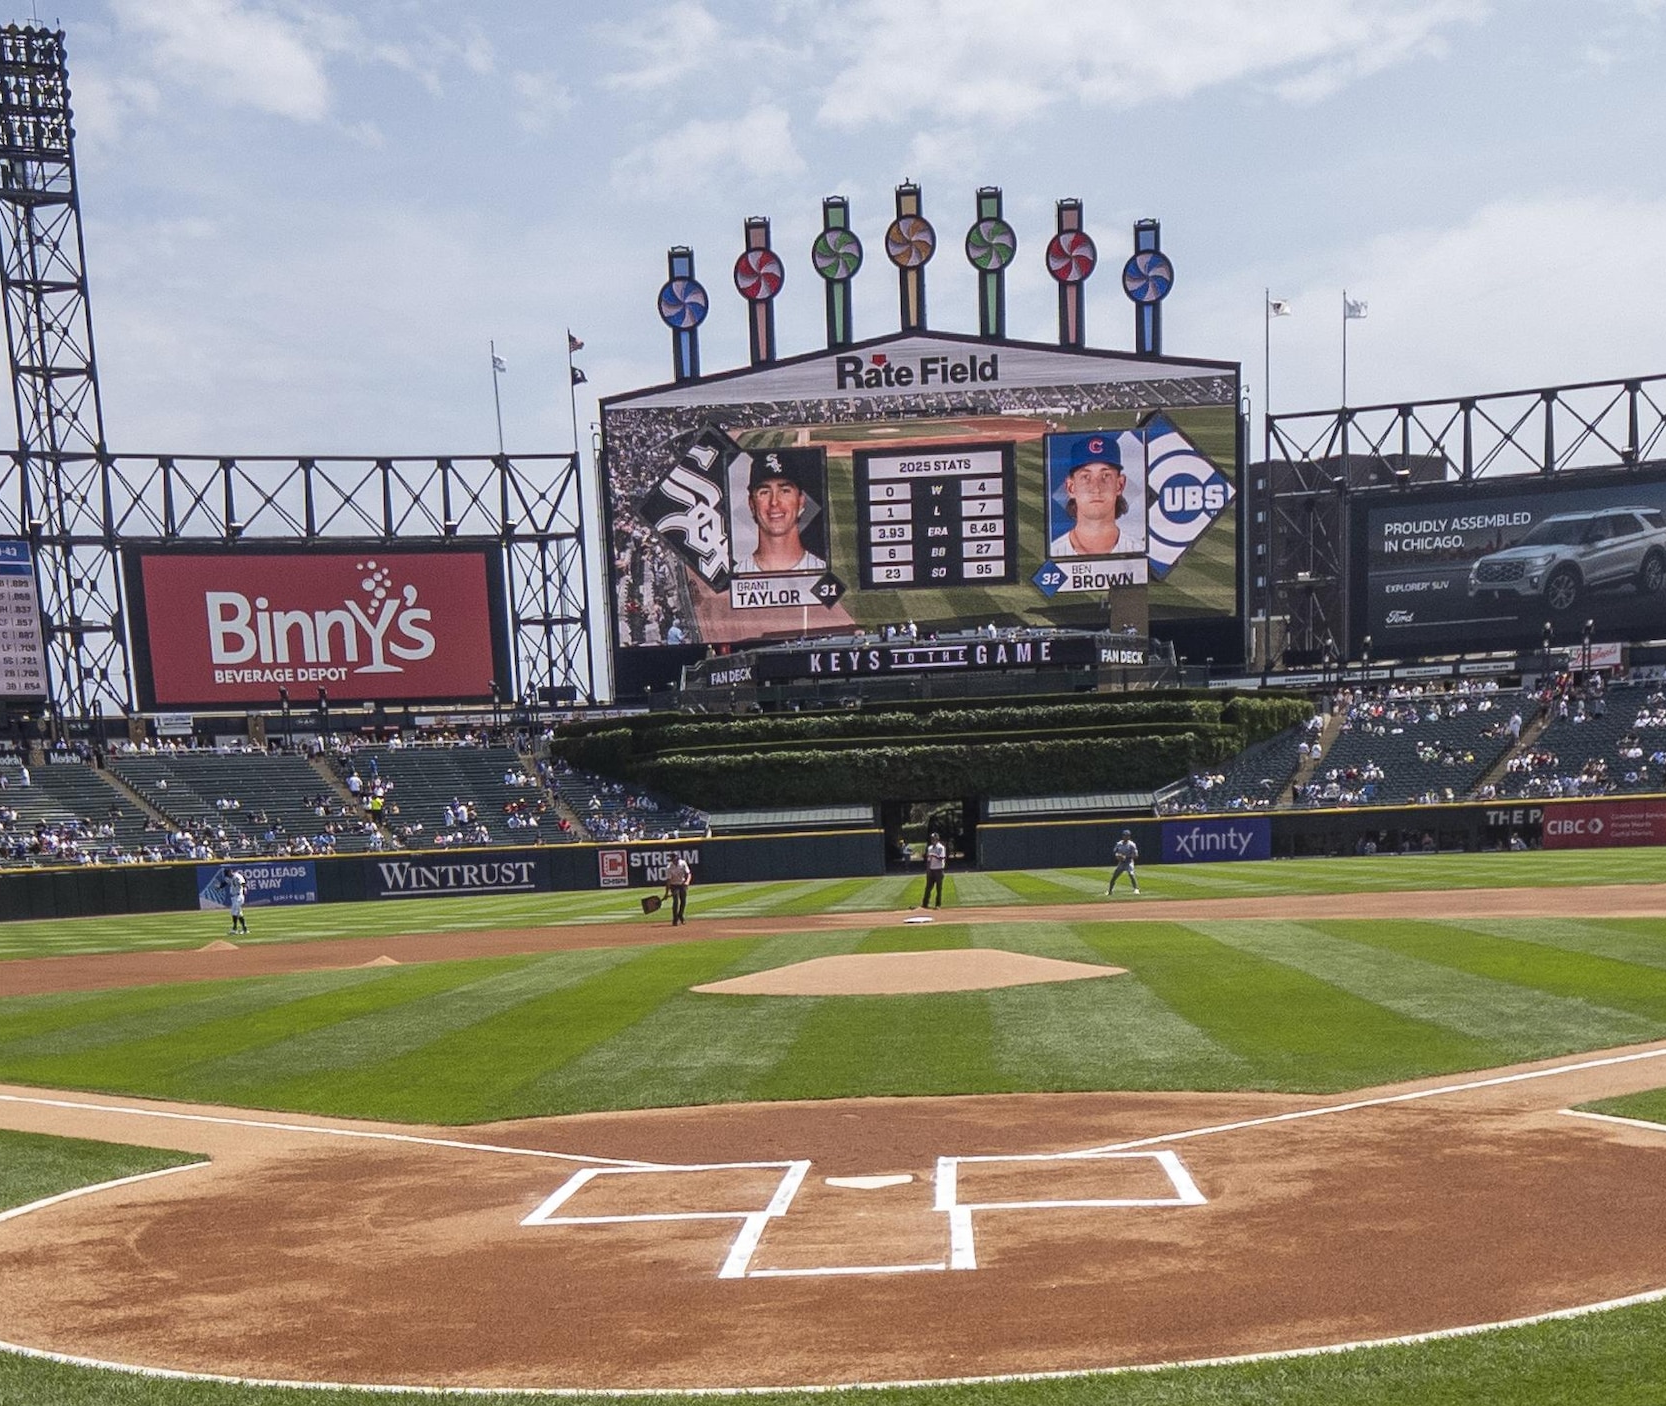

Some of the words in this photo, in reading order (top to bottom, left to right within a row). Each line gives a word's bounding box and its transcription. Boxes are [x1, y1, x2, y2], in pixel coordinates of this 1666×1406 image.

[836, 356, 913, 390] Rate
[921, 354, 998, 385] Field
[900, 462, 931, 472] 2025
[934, 459, 971, 471] STATS
[886, 487, 894, 497] 0
[931, 486, 942, 495] W
[978, 483, 986, 492] 4
[888, 508, 894, 517] 1
[934, 506, 940, 515] L
[978, 503, 986, 512] 7
[1385, 519, 1448, 535] PROUDLY
[1451, 512, 1531, 530] ASSEMBLED
[928, 527, 948, 536] ERA
[889, 549, 895, 558] 6
[976, 544, 991, 554] 27
[1385, 540, 1398, 553] IN
[1402, 536, 1465, 551] CHICAGO.
[886, 569, 900, 579] 23
[932, 568, 946, 577] SO
[976, 565, 992, 574] 95
[1042, 573, 1060, 584] 32
[1072, 565, 1091, 574] BEN
[737, 582, 769, 591] GRANT
[1072, 573, 1133, 589] BROWN
[1432, 581, 1449, 590] SUV
[738, 591, 800, 605] TAYLOR
[820, 585, 837, 596] 31
[1386, 610, 1414, 623] Ford
[811, 651, 880, 673] KEYS
[891, 653, 915, 664] TO
[928, 650, 965, 663] THE
[977, 642, 1051, 665] GAME
[1101, 650, 1118, 664] FAN
[1120, 649, 1143, 665] DECK
[215, 669, 294, 684] BEVERAGE
[298, 668, 348, 682] DEPOT
[711, 672, 728, 685] FAN
[730, 667, 752, 683] DECK
[50, 752, 81, 765] Modelo
[1486, 810, 1524, 825] THE
[1547, 820, 1585, 835] CIBC
[1176, 827, 1253, 858] xfinity
[271, 867, 306, 877] LEADS
[378, 862, 536, 888] WINTRUST
[258, 879, 282, 889] WAY
